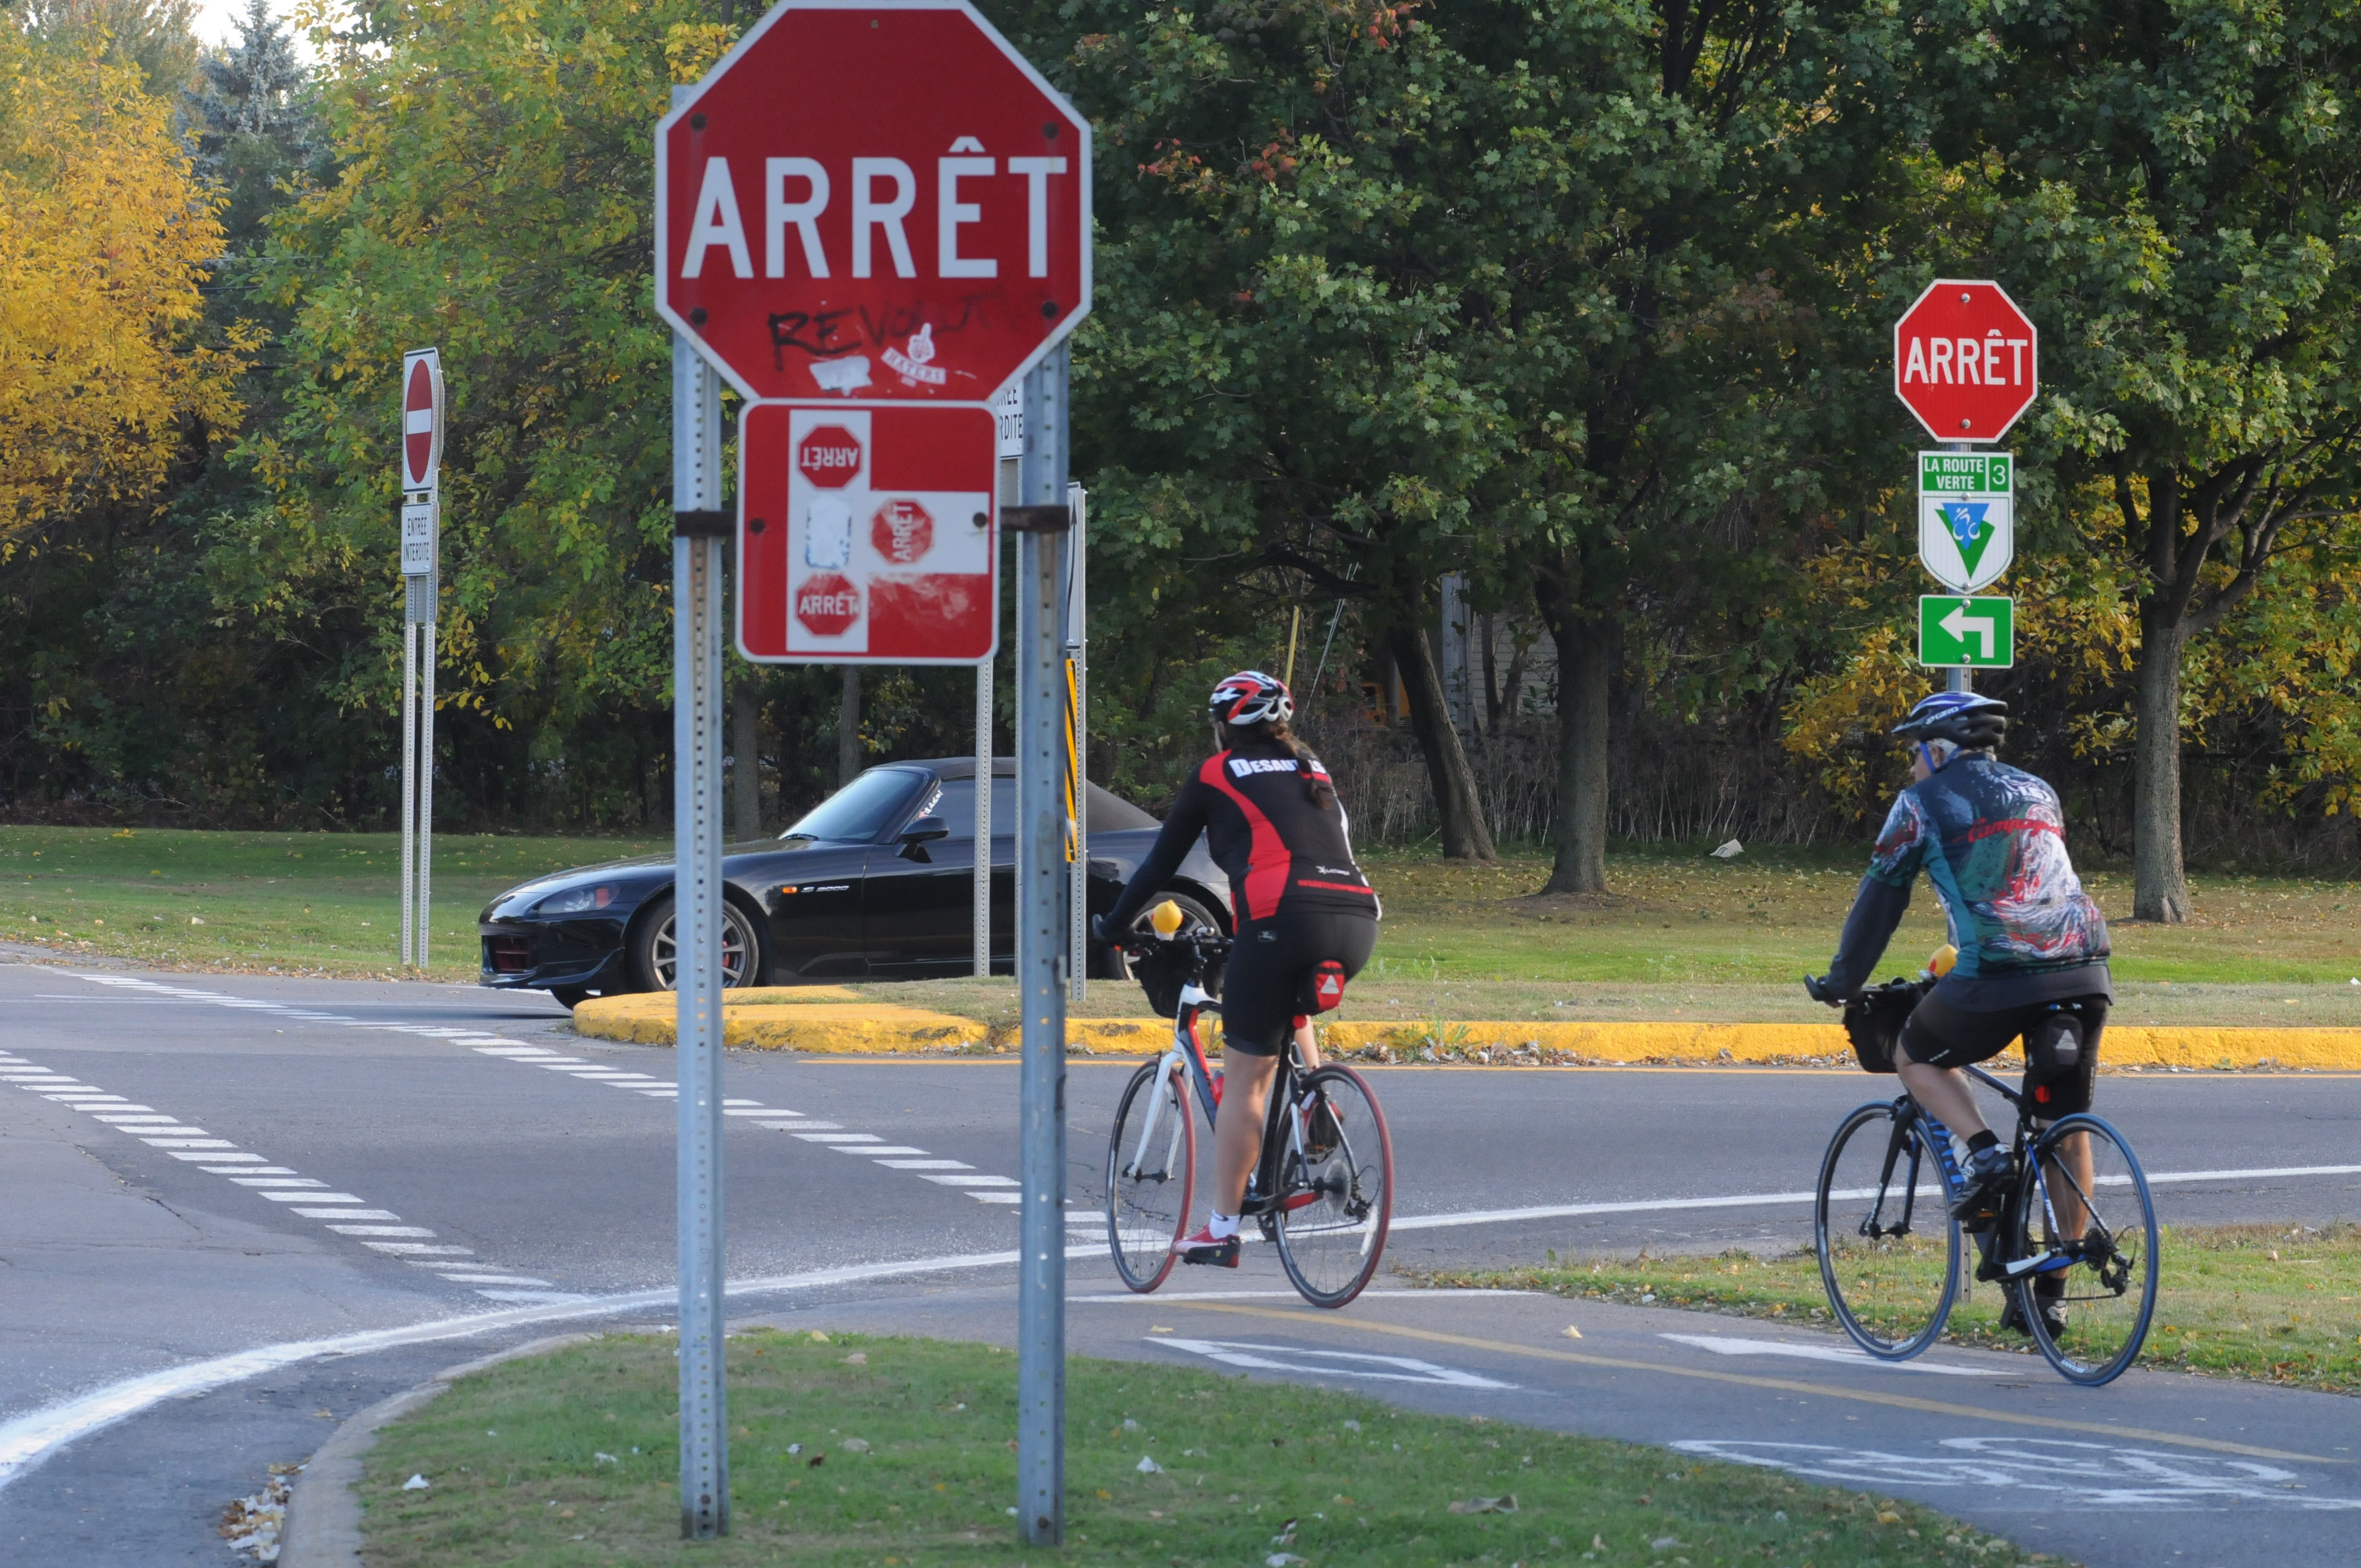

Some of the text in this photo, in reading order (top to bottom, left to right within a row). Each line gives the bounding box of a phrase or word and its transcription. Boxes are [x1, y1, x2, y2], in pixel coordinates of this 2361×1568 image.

[681, 136, 1068, 279] ARRÊT
[1903, 329, 2028, 385] ARRÊT
[802, 447, 859, 471] ARRÊT
[1924, 458, 1984, 473] LA ROUTE
[1936, 475, 1974, 489] VERTE
[1992, 465, 2006, 485] 3
[407, 513, 427, 536] ENTRÉE
[404, 542, 429, 562] INTERDITE
[798, 591, 856, 615] ARRÊT
